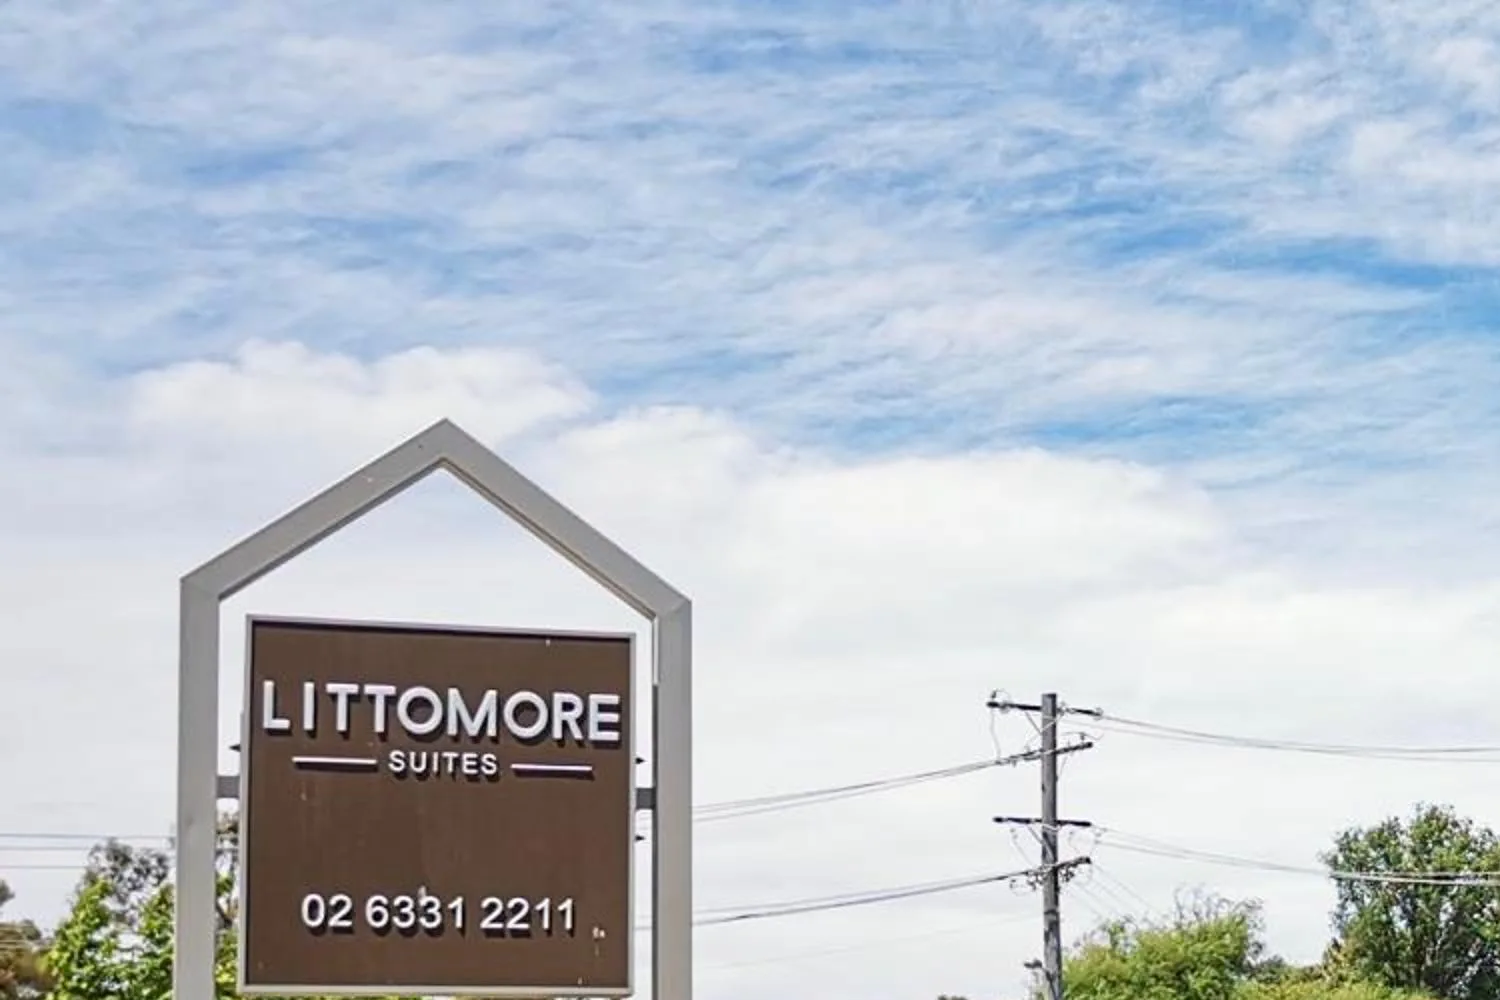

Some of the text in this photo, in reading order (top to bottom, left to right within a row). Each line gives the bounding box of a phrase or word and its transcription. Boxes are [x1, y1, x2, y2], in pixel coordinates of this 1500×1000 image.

[262, 680, 620, 742] LITTOMORE
[388, 750, 499, 775] SUITES
[301, 893, 575, 931] 02 6331 2211
